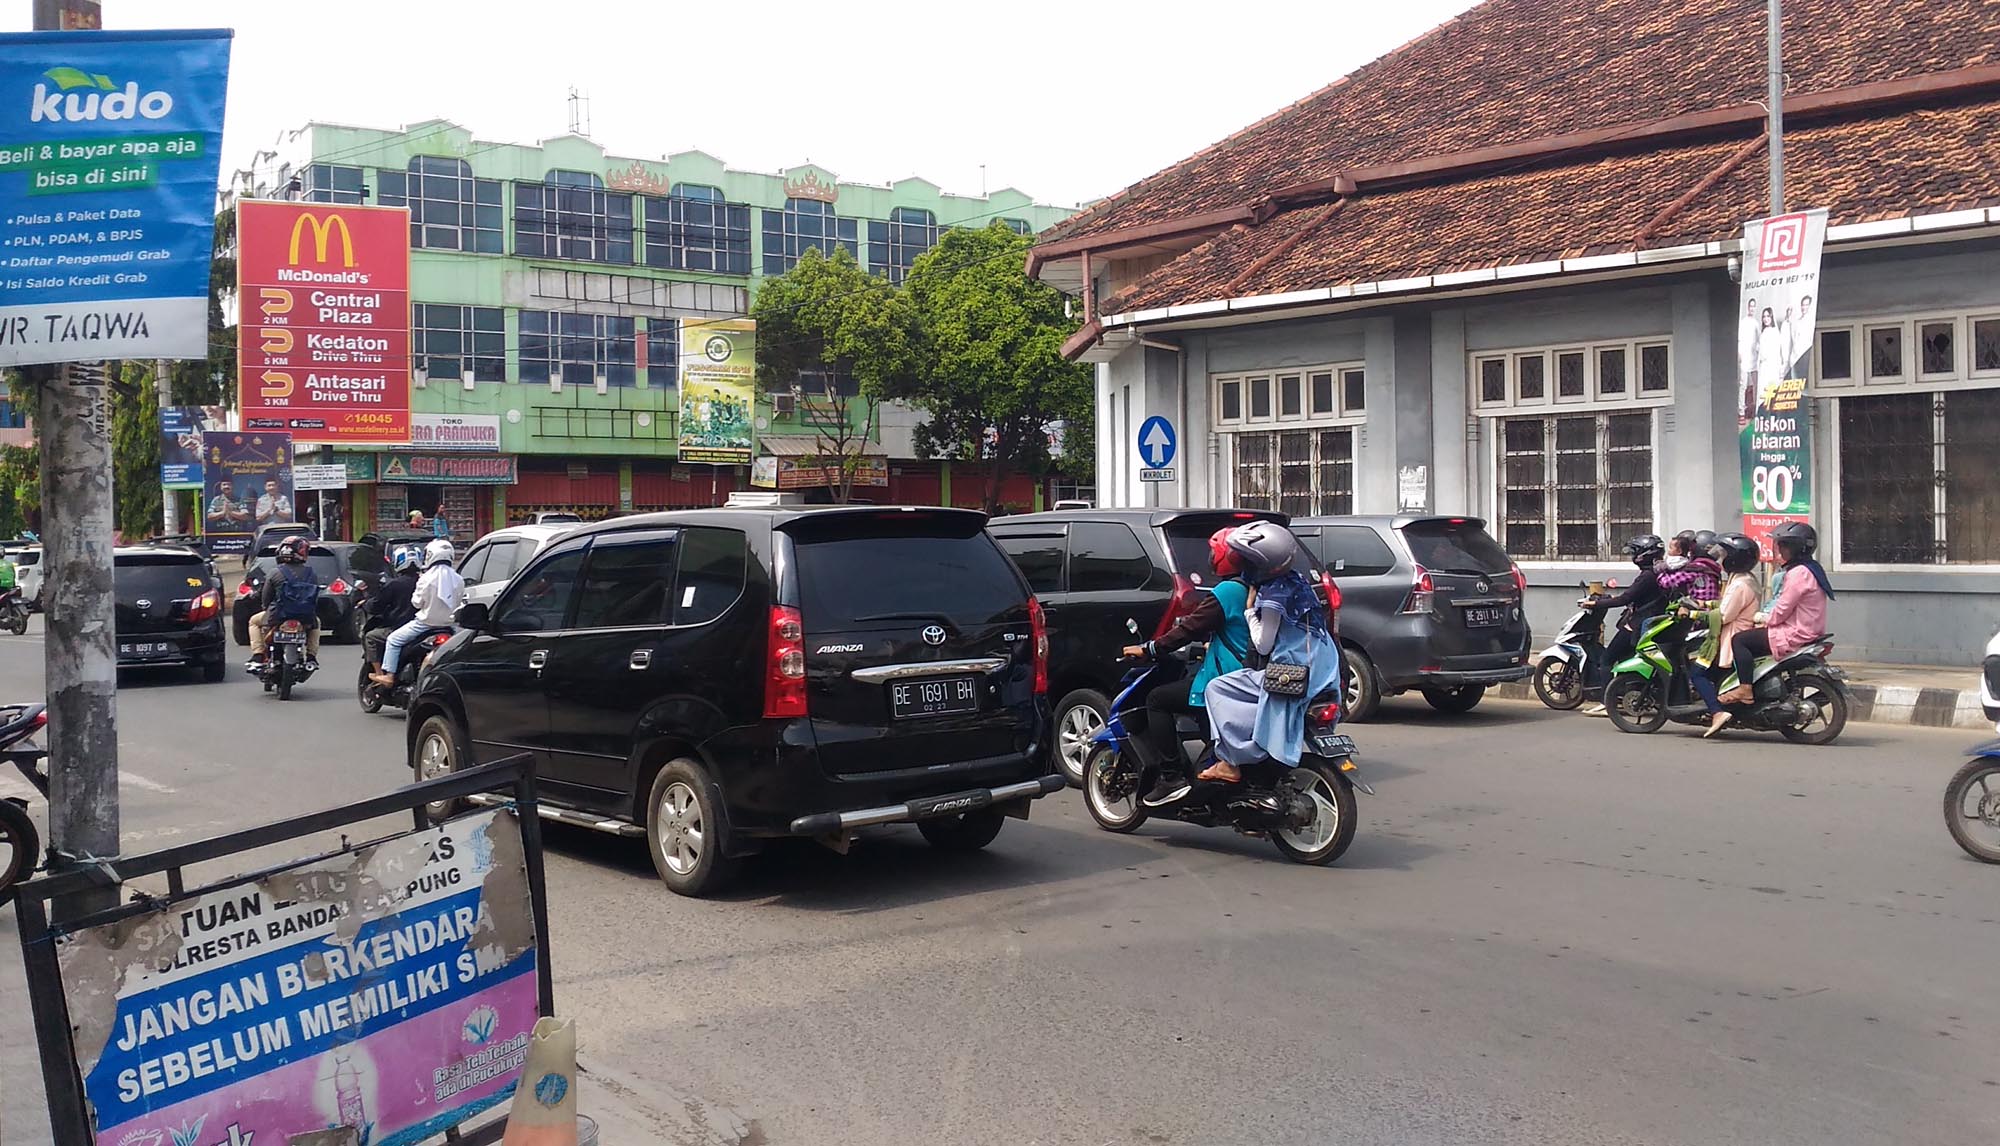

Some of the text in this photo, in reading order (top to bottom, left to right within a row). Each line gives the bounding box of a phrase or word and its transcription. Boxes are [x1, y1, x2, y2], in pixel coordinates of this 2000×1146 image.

[31, 82, 173, 122] kudo
[0, 138, 197, 164] Beli & bayar apa aja
[36, 165, 148, 188] bisa di sini
[16, 208, 141, 226] Pulsa & Paket Data
[14, 229, 143, 248] PLN, PDAM, & BPJS
[10, 248, 170, 268] Daftar Pengemudi Grab
[6, 271, 148, 289] Isi Saldo Kredit Grab
[278, 269, 369, 284] McDonald's
[1745, 279, 1768, 290] MULAI
[311, 291, 381, 308] Central
[319, 308, 373, 324] Plaza
[44, 312, 149, 343] TAQWA
[307, 334, 388, 350] Kedaton
[312, 351, 382, 363] Drive Thru
[305, 374, 386, 390] Antasari
[272, 398, 288, 406] KM
[312, 391, 382, 402] Drive Thru
[355, 414, 393, 424] 14045
[1754, 416, 1796, 433] Diskon
[411, 425, 497, 441] RA PRAMUKA
[1752, 434, 1801, 450] Lebaran
[1752, 464, 1802, 512] 80%
[816, 644, 863, 654] AVANZA
[894, 681, 973, 705] BE 1691 BH
[117, 972, 269, 1051] JANGAN
[117, 1017, 292, 1103] SEBELUM
[299, 962, 449, 1041] MEMILIKI
[434, 1034, 529, 1085] Rasa Teh Terbaik
[436, 1084, 457, 1101] ada
[460, 1076, 471, 1091] di
